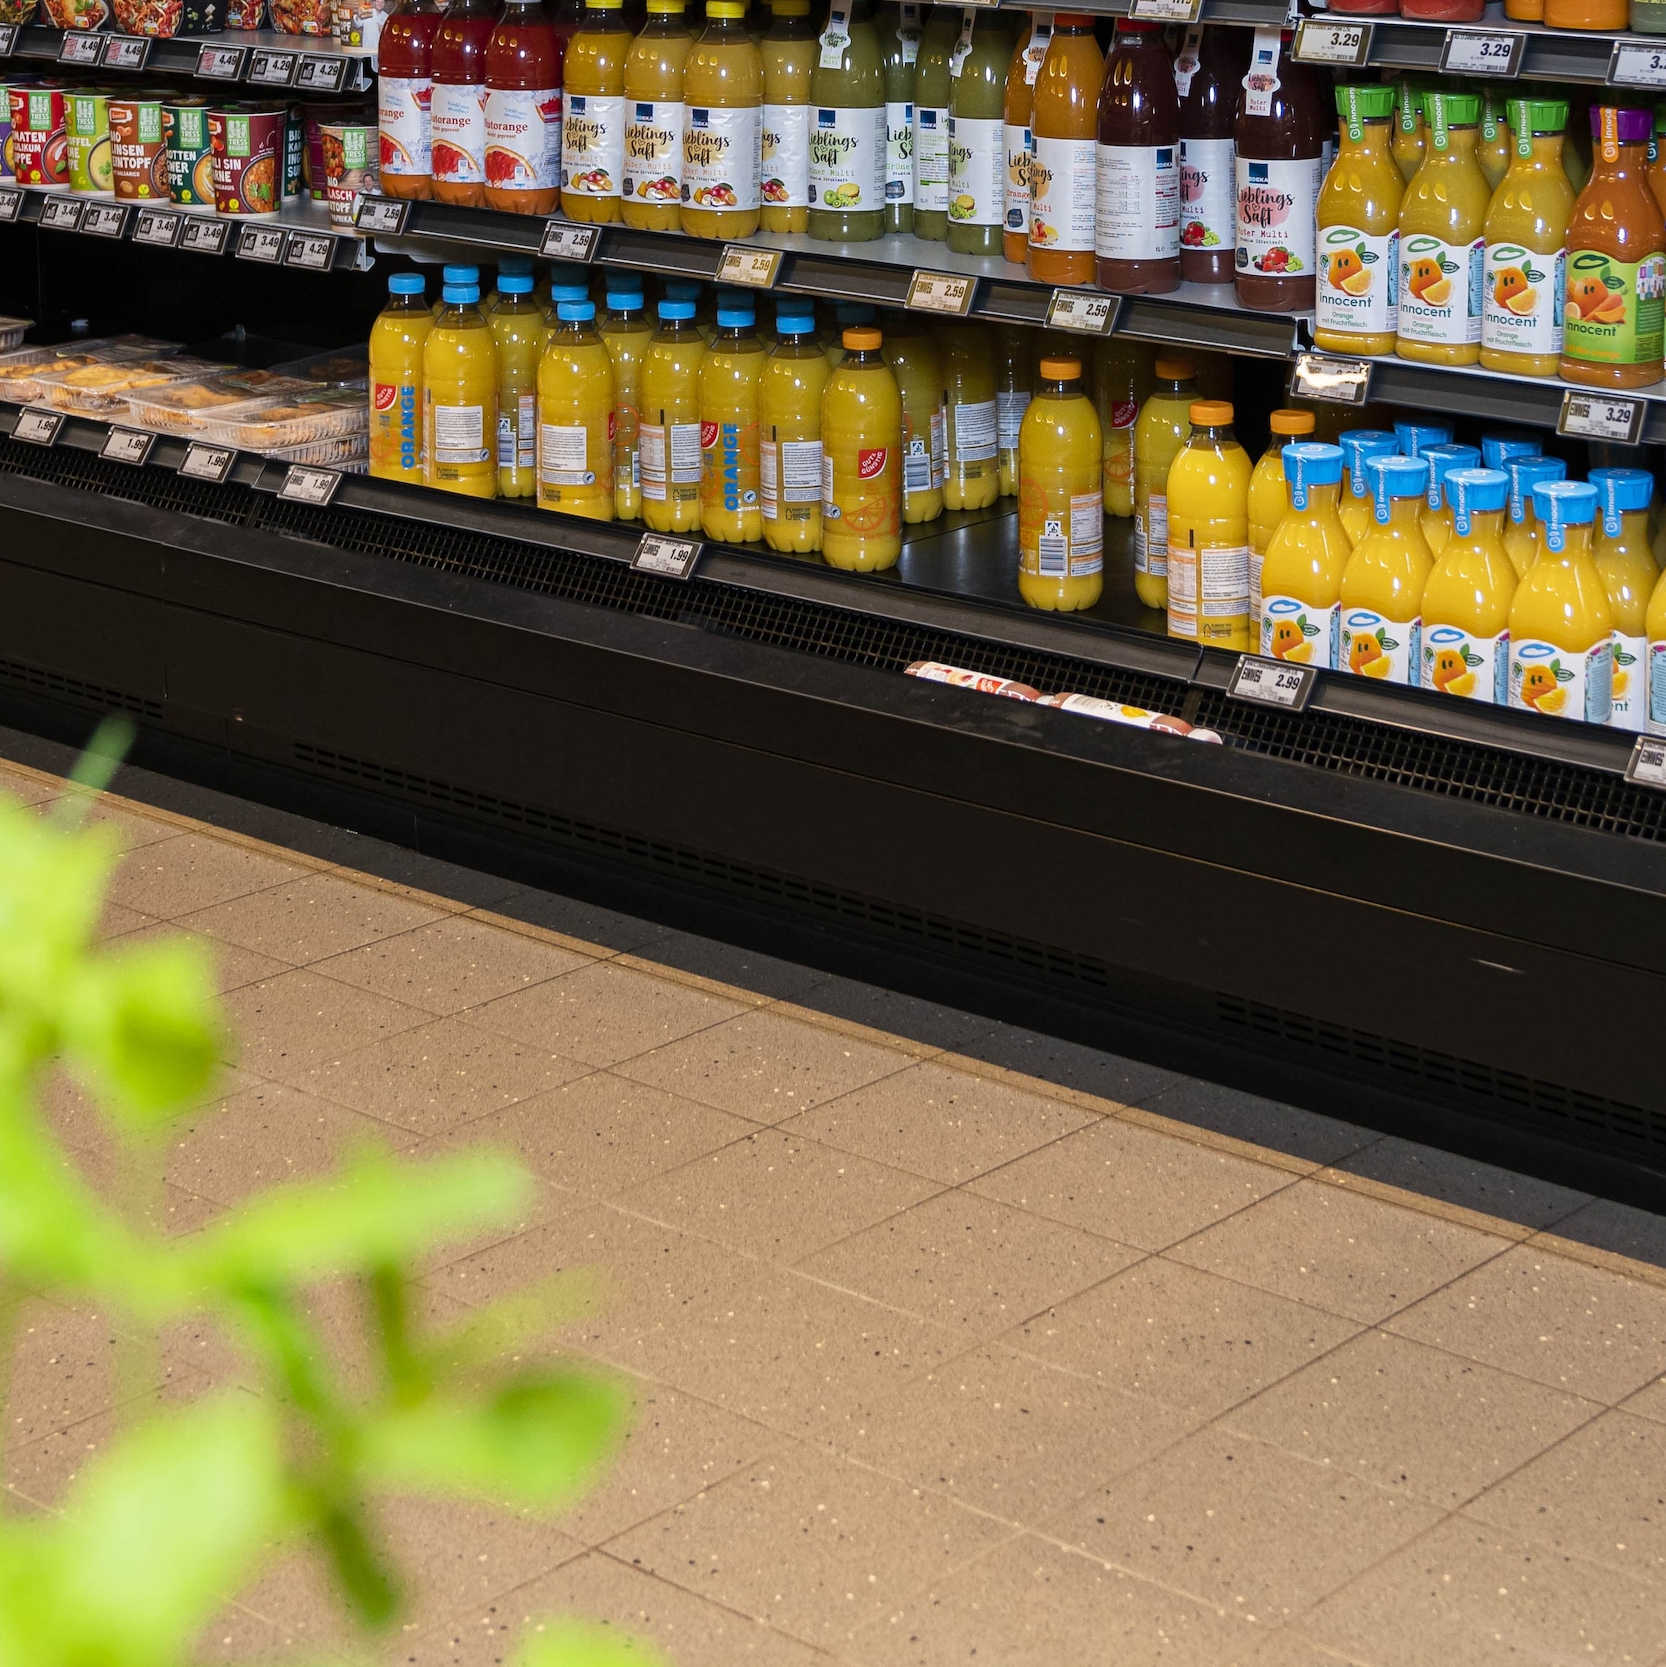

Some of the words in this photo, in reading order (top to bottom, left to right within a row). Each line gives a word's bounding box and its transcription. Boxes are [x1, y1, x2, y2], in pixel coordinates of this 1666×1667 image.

[1331, 31, 1360, 49] 3.29
[1479, 42, 1511, 58] 3.29
[228, 138, 249, 147] TRESS
[111, 144, 145, 158] LINSEN
[112, 156, 151, 170] EINTOPF
[261, 235, 280, 248] 3.49
[1260, 229, 1289, 239] Multi
[1319, 293, 1373, 308] innocent
[1085, 303, 1108, 317] 2.59
[1331, 311, 1354, 320] Orange
[1399, 303, 1453, 319] innocent
[1569, 403, 1591, 419] EINWEG
[1605, 407, 1631, 424] 3.29
[400, 385, 416, 470] ORANGE
[723, 423, 739, 512] ORANGE
[1275, 673, 1300, 690] 2.99
[1640, 751, 1663, 768] EINWEG
